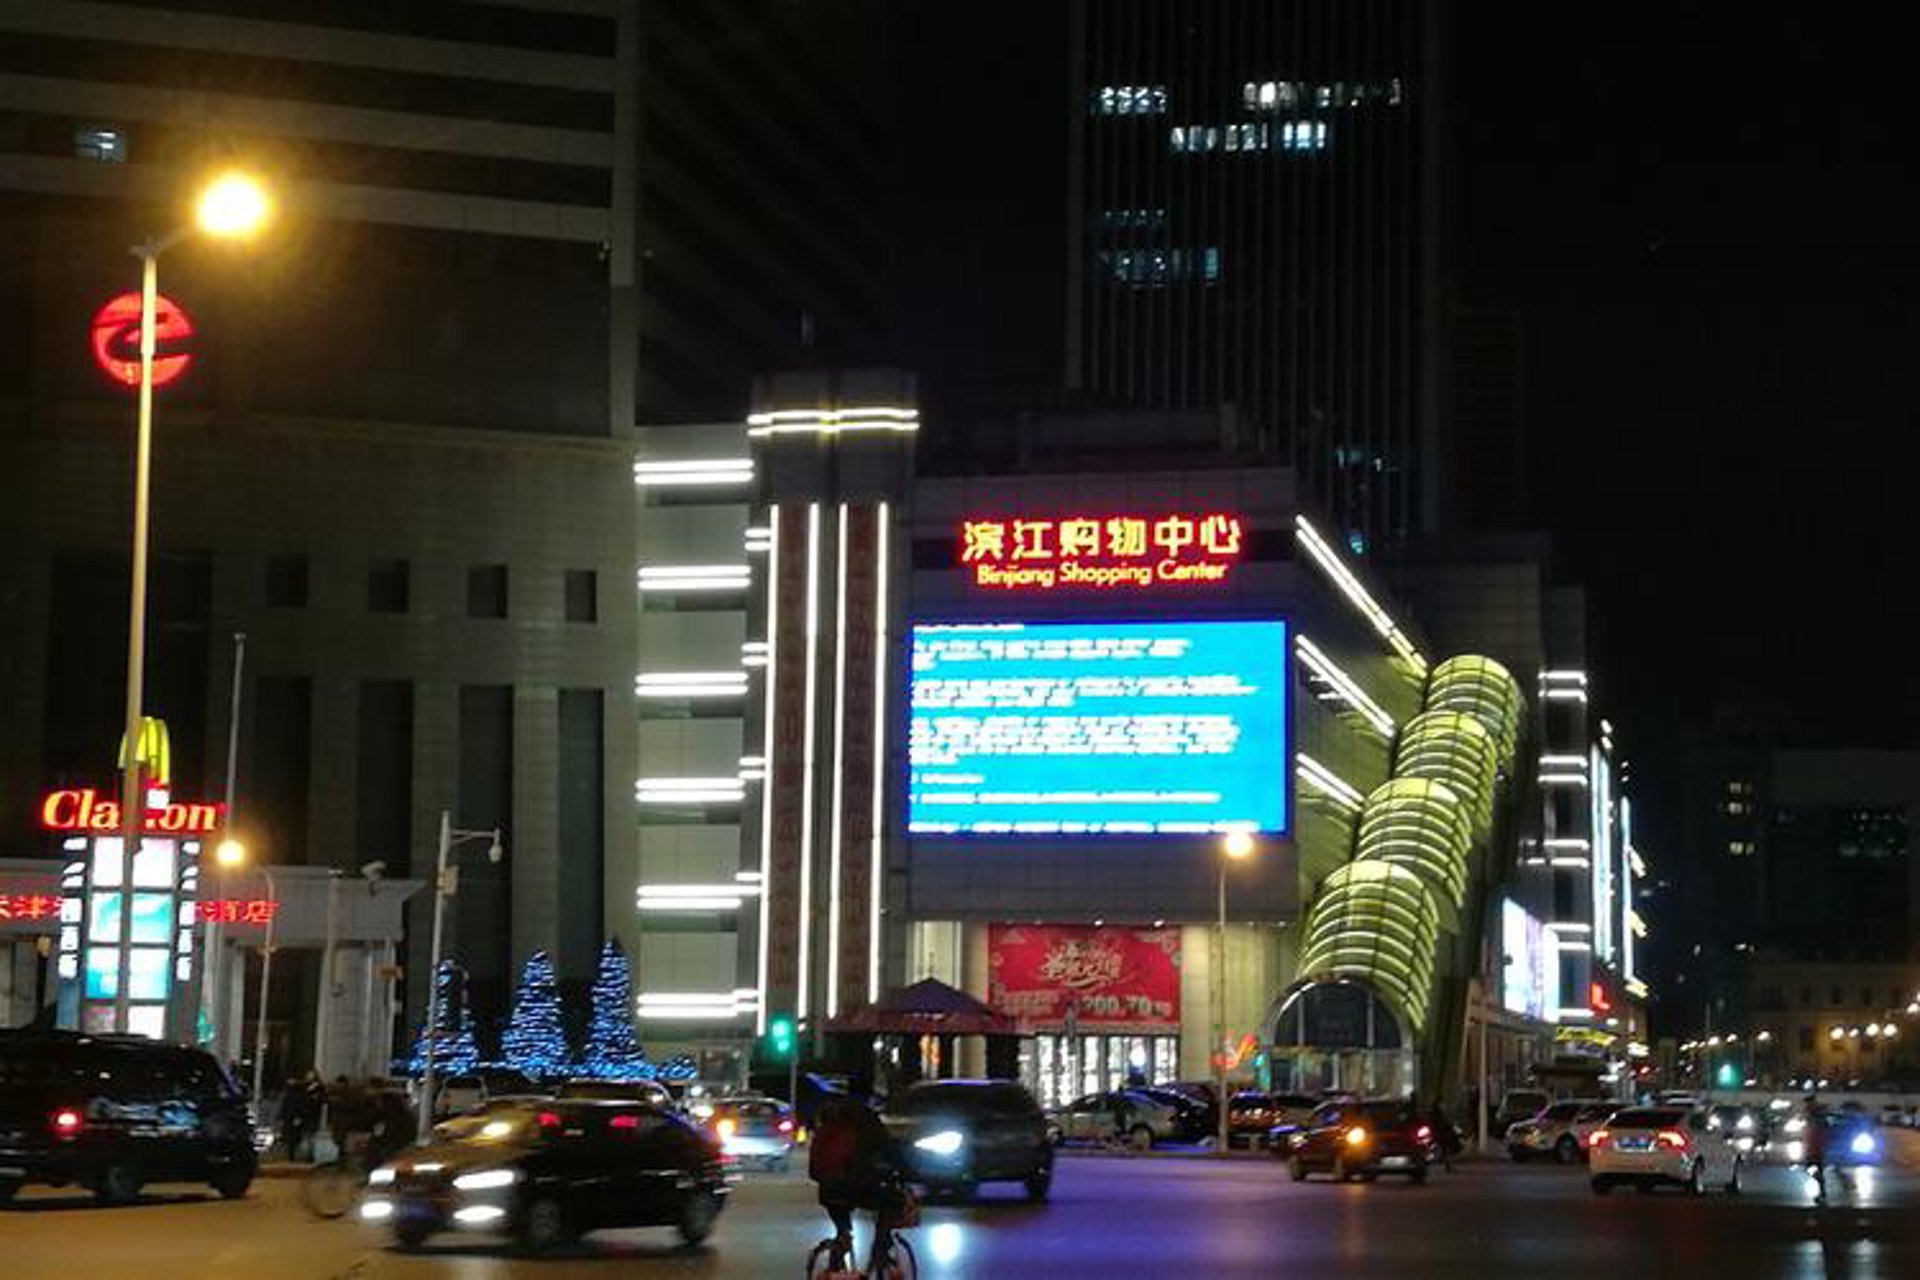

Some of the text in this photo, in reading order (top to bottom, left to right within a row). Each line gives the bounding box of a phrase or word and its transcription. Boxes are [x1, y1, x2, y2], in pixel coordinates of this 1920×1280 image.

[962, 515, 1241, 561] 滨江购物中心
[977, 559, 1227, 587] Binjiang Shopping Center
[43, 789, 216, 832] Claon
